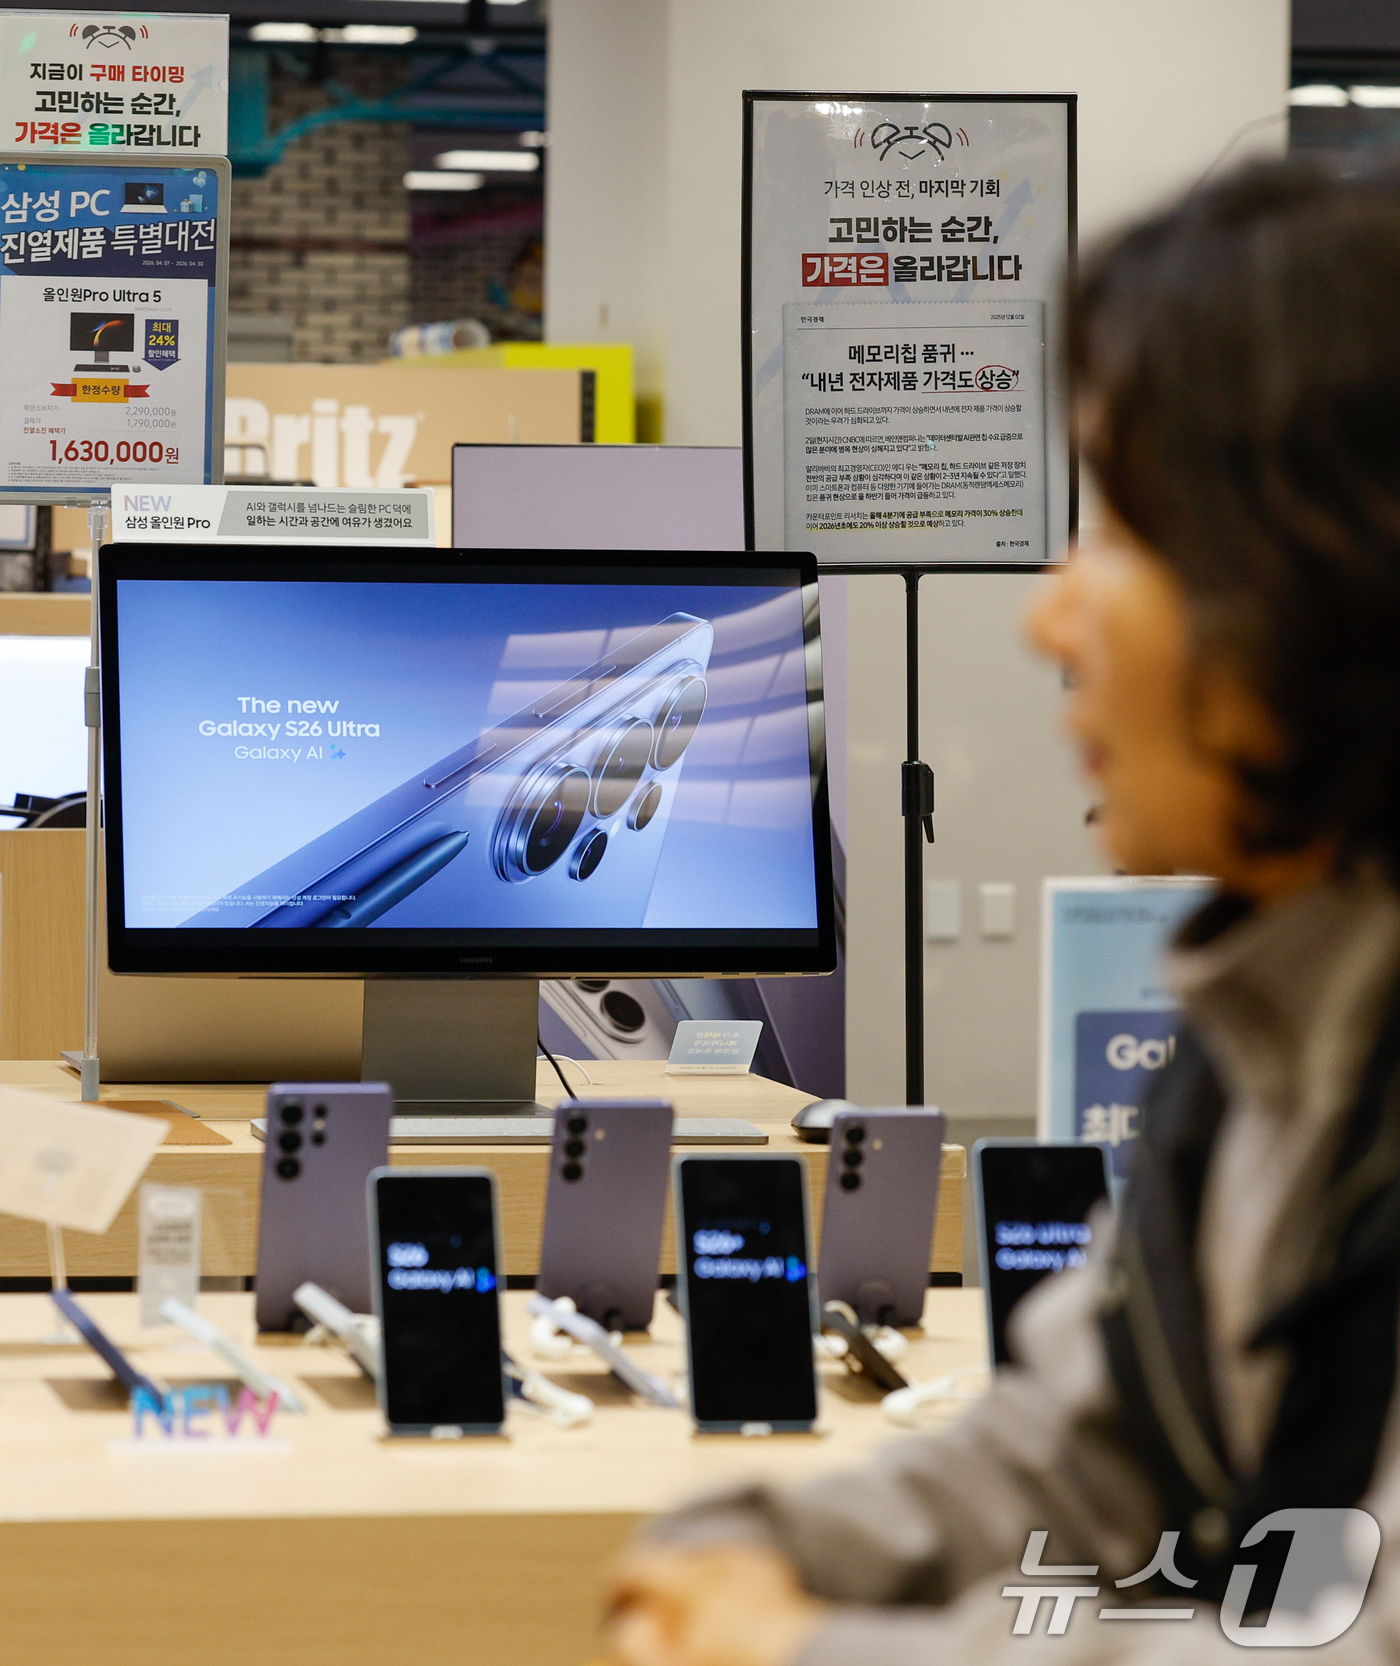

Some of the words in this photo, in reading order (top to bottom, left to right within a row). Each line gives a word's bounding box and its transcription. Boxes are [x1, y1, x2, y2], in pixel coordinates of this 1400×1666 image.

[30, 63, 83, 80] 지금이
[90, 65, 124, 82] 구매
[132, 66, 184, 83] 타이밍
[35, 91, 124, 114] 고민하는
[131, 93, 181, 117] 순간,
[15, 122, 82, 144] 가격은
[88, 123, 201, 147] 올라갑니다
[824, 180, 854, 198] 가격
[860, 180, 891, 198] 인상
[895, 180, 914, 199] 전,
[919, 180, 966, 198] 마지막
[970, 180, 1000, 197] 기회
[1, 191, 60, 223] 삼성
[70, 190, 111, 217] PC
[829, 217, 932, 243] 고민하는
[941, 216, 998, 244] 순간,
[1, 226, 106, 264] 진열제품
[111, 218, 216, 256] 특별대전
[806, 257, 884, 283] 가격은
[893, 255, 1022, 282] 올라갑니다
[43, 288, 109, 302] 올인원Pro
[113, 289, 149, 303] Ultra
[153, 291, 161, 303] 5
[152, 322, 172, 333] 최대
[148, 335, 175, 346] 24%
[148, 349, 176, 358] 할인혜택
[849, 344, 917, 364] 메모리칩
[922, 343, 956, 363] 품귀
[850, 371, 918, 391] 전자제품
[923, 370, 974, 390] 가격도
[82, 384, 121, 395] 한정수량
[125, 406, 176, 417] 2,290,000원
[893, 406, 911, 414] 가격이
[943, 405, 960, 413] 내년에
[961, 405, 972, 413] 전자
[1004, 404, 1021, 412] 상승할
[127, 419, 176, 429] 1,790,000원
[875, 416, 889, 424] 있다.
[225, 398, 417, 488] Britz
[50, 440, 179, 465] 1,630,000원
[806, 465, 836, 473] 알리바바의
[949, 462, 961, 470] 하드
[124, 495, 172, 512] NEW
[246, 502, 266, 513] AI와
[268, 502, 306, 513] 갤럭시를
[308, 502, 346, 514] 넘나드는
[348, 503, 377, 514] 슬림한
[379, 504, 391, 513] PC
[393, 503, 412, 515] 덕에
[125, 516, 148, 529] 삼성
[150, 516, 185, 529] 올인원
[188, 518, 211, 529] Pro
[247, 515, 276, 527] 일하는
[279, 515, 308, 528] 시간과
[310, 515, 340, 528] 공간에
[342, 516, 372, 528] 여유가
[374, 516, 413, 529] 생겼어요
[927, 520, 950, 528] 예상하고
[237, 697, 281, 713] The
[288, 700, 339, 713] new
[199, 720, 281, 741] Galaxy
[285, 721, 323, 737] S26
[327, 721, 380, 737] Ultra
[234, 746, 301, 763] Galaxy
[306, 746, 323, 759] AI
[131, 1386, 279, 1439] NEW
